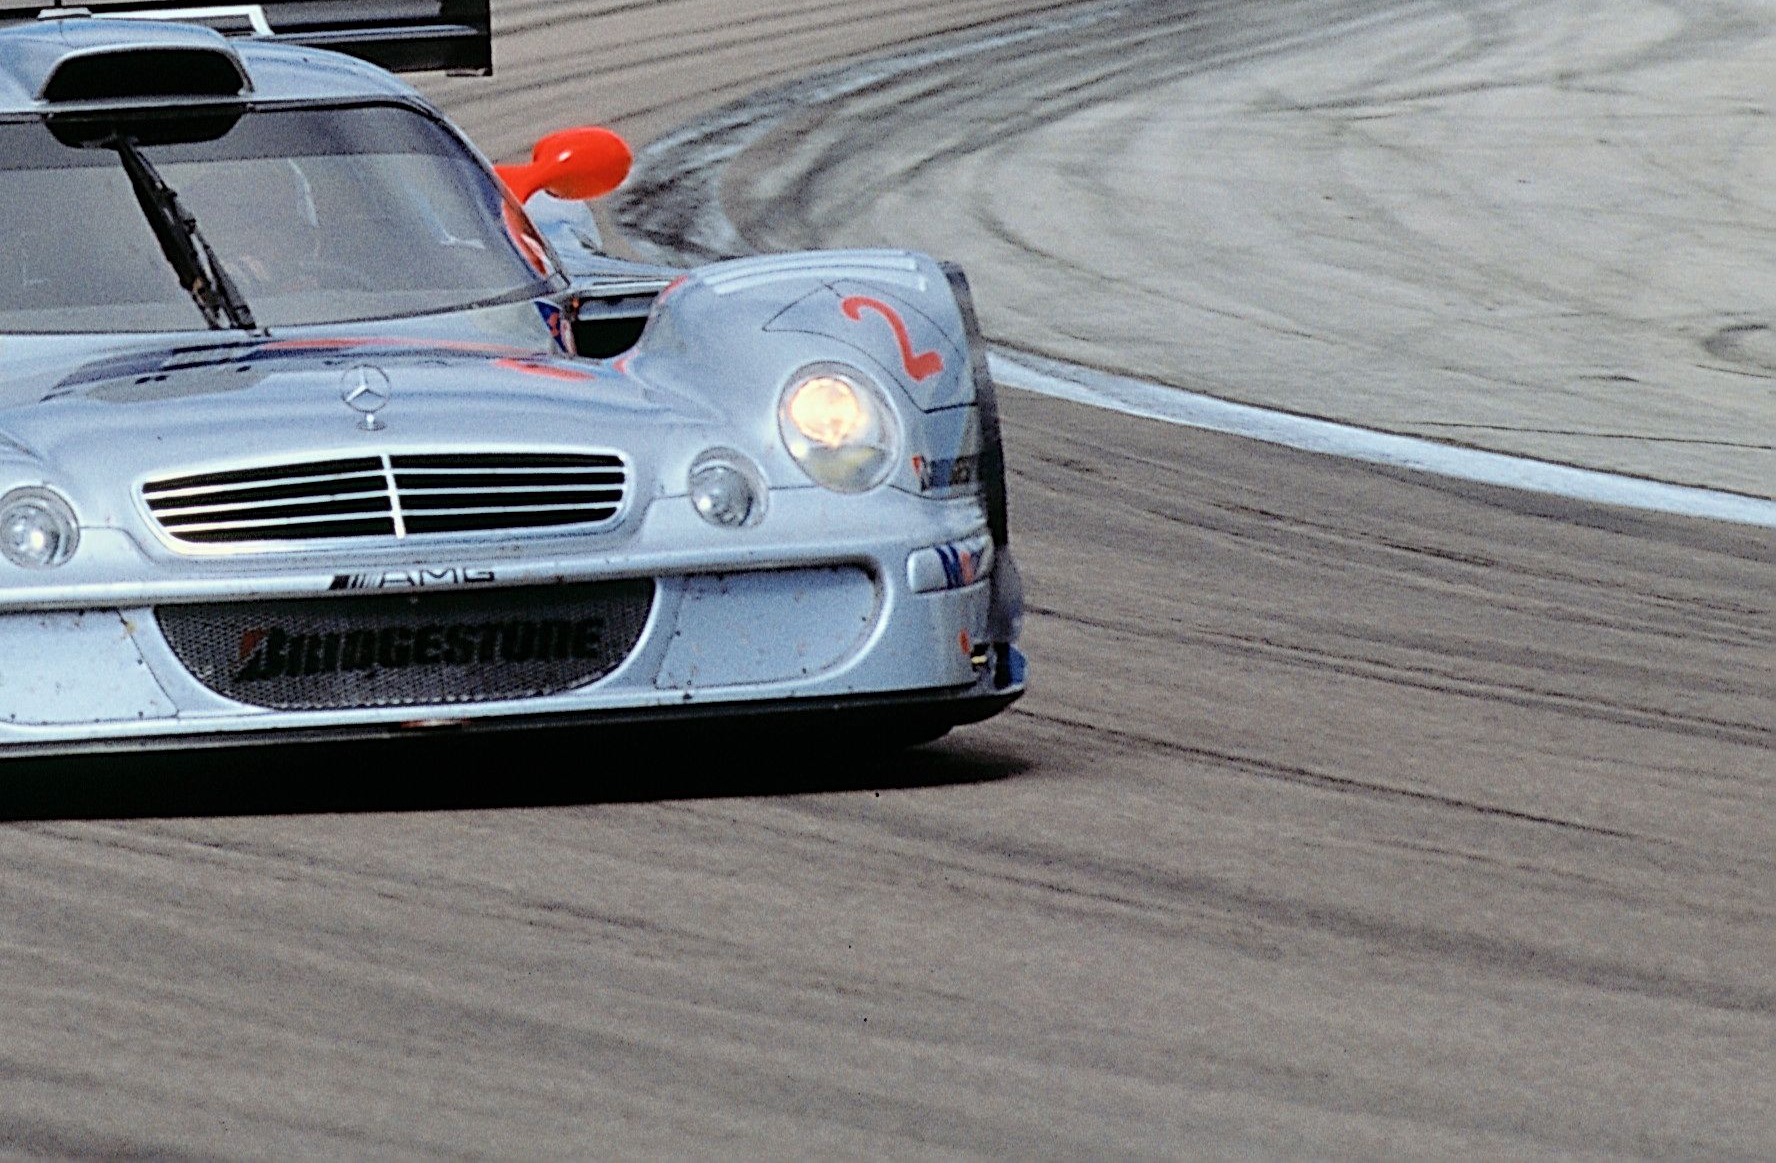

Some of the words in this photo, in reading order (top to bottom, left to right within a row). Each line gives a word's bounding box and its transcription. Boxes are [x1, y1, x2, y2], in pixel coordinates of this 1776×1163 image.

[840, 296, 945, 382] 2
[378, 567, 496, 589] AMG
[235, 618, 606, 682] BRIDGESTONE
